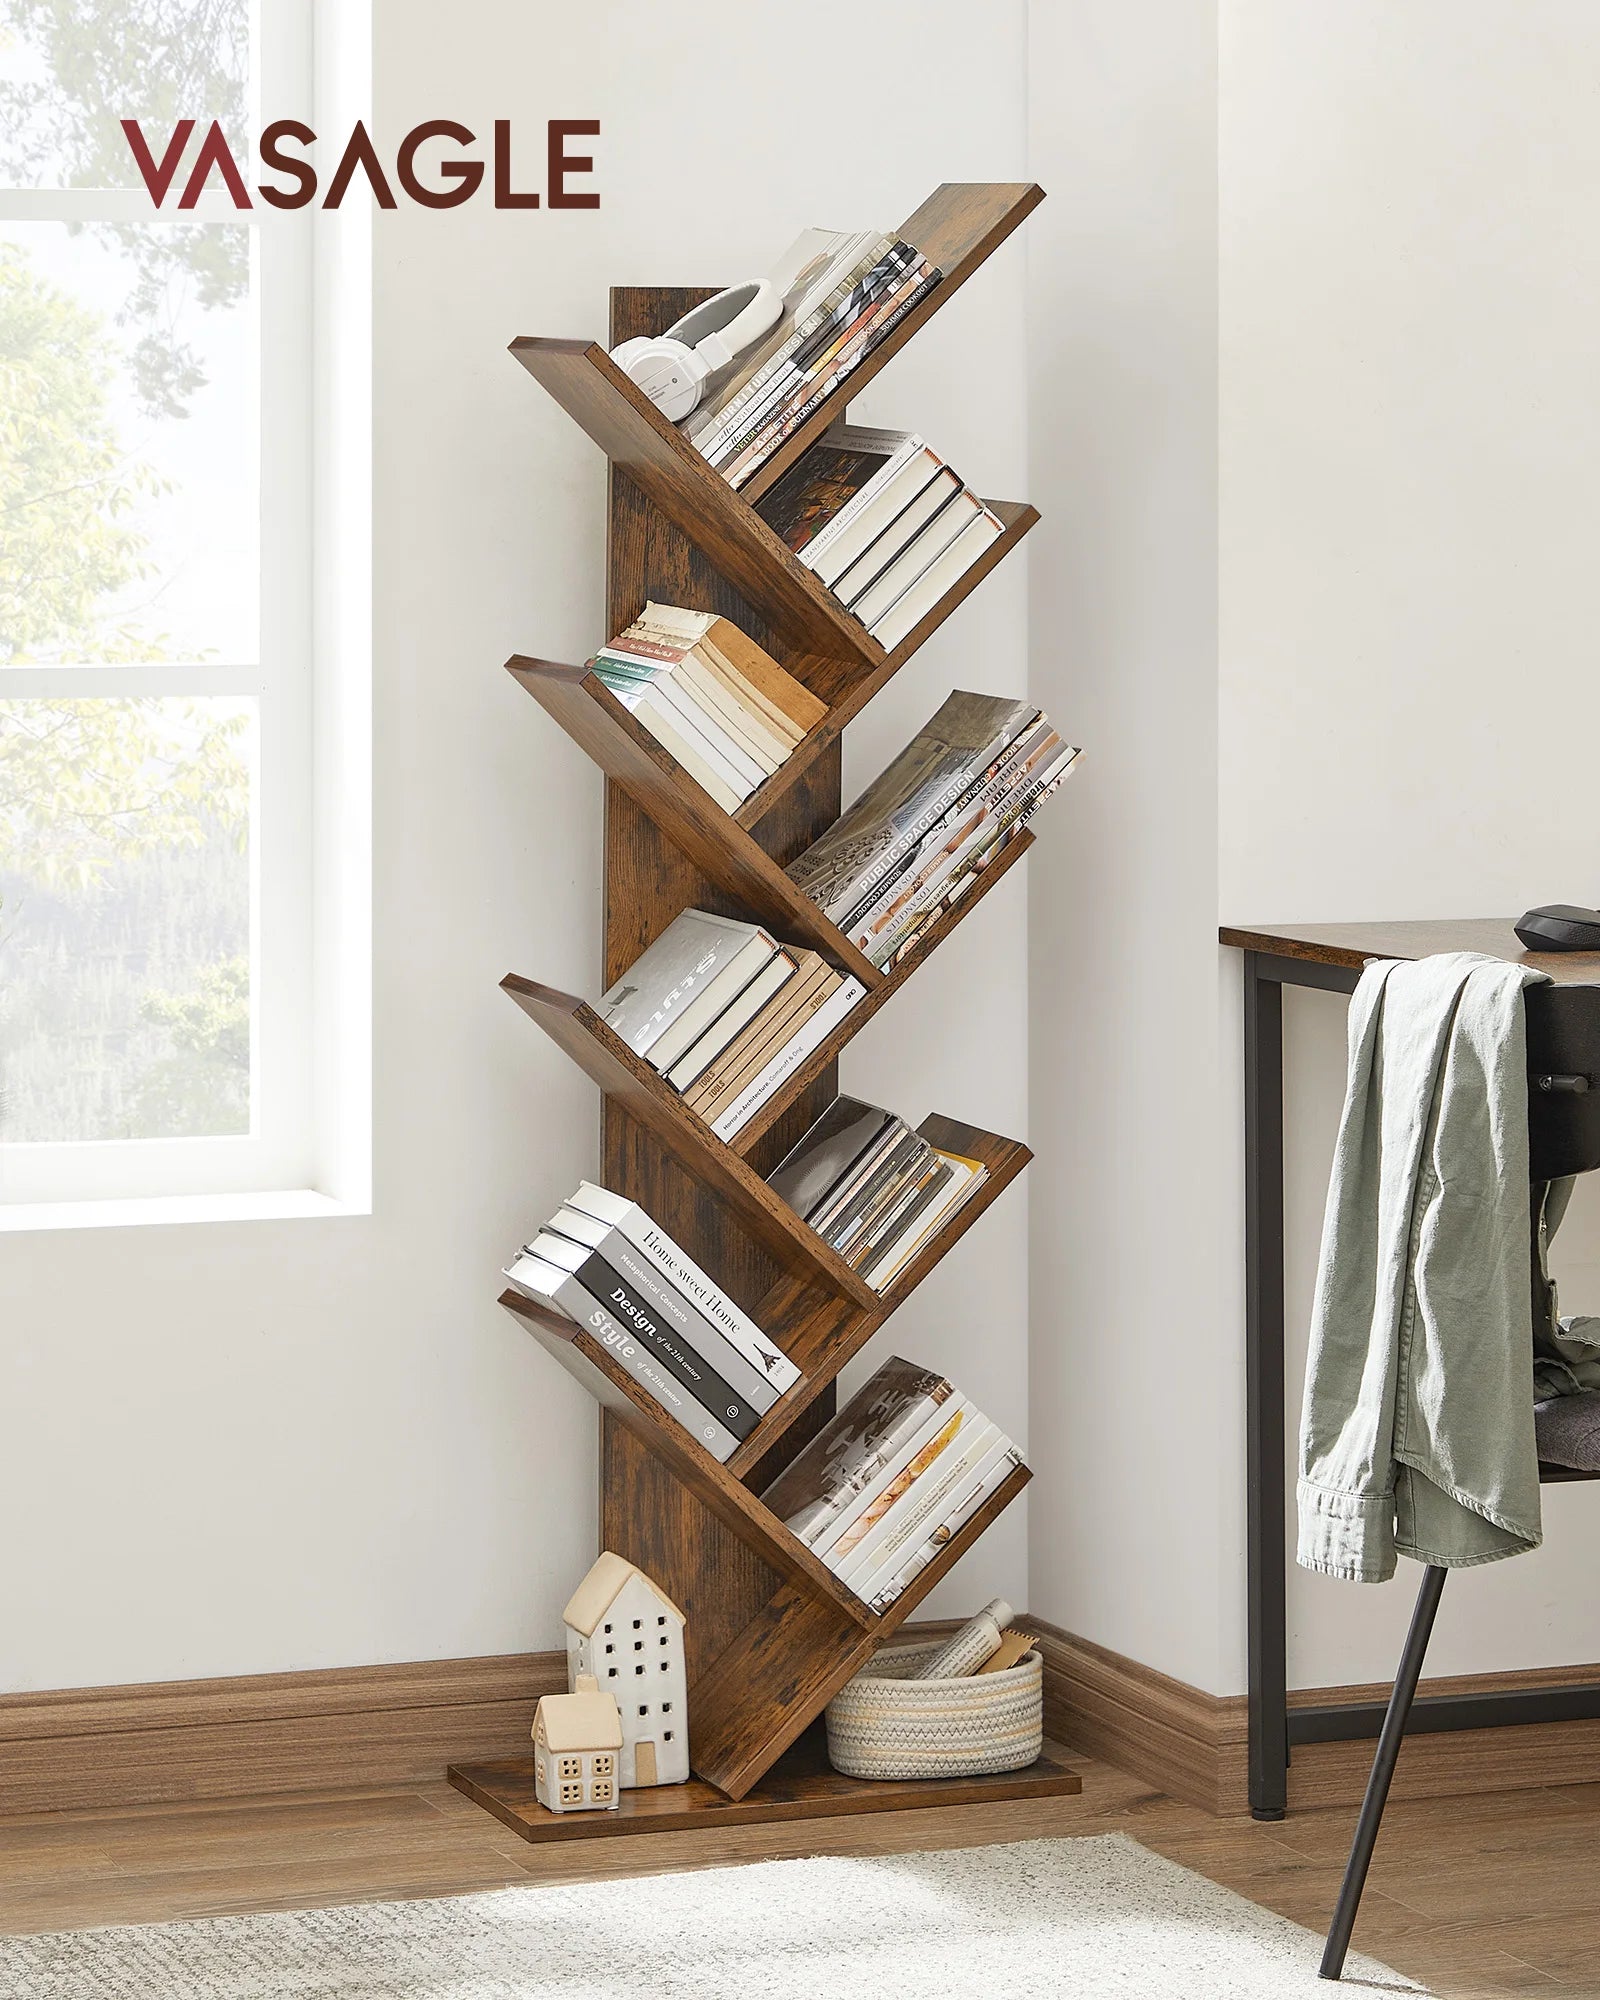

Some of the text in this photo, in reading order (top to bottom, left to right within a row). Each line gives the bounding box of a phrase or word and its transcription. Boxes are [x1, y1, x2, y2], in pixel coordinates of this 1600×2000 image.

[879, 306, 905, 332] SUMMER
[901, 282, 928, 310] COOKOUT
[837, 313, 885, 362] SUMMER COOKOUT
[714, 318, 818, 427] FURNITURE DESIGN
[771, 365, 790, 385] Book
[779, 374, 798, 393] Book
[733, 404, 782, 453] VETER MAGAZINE
[754, 399, 801, 449] APPETITE
[761, 433, 784, 455] BOOK
[789, 390, 825, 427] CULINARY
[834, 491, 869, 527] ARCHITECTURE
[995, 744, 1017, 767] BOOK
[958, 771, 992, 808] CULINARY
[979, 760, 1018, 802] DREAM
[983, 763, 1029, 812] APPETITE
[993, 776, 1033, 819] DREAM
[858, 769, 976, 891] PUBLIC SPACE DESIGN
[925, 849, 949, 874] SUMMER
[854, 868, 902, 919] SUMMER COOKOUT
[870, 869, 916, 918] LOS ANGELES
[901, 870, 929, 900] COOKOUT
[914, 885, 930, 902] LOS
[884, 899, 917, 935] ANGELES
[891, 911, 923, 945] competitors
[809, 991, 827, 1009] TOOLS
[697, 1070, 716, 1088] TOOLS
[707, 1079, 725, 1098] TOOLS
[722, 1113, 739, 1130] Horror
[736, 1108, 743, 1116] in
[620, 1253, 689, 1323] Metaphorical Concepts
[641, 1229, 743, 1334] Home sweet Home
[609, 1285, 701, 1382] Design of the 21th century
[587, 1308, 682, 1407] Style of the 21th century
